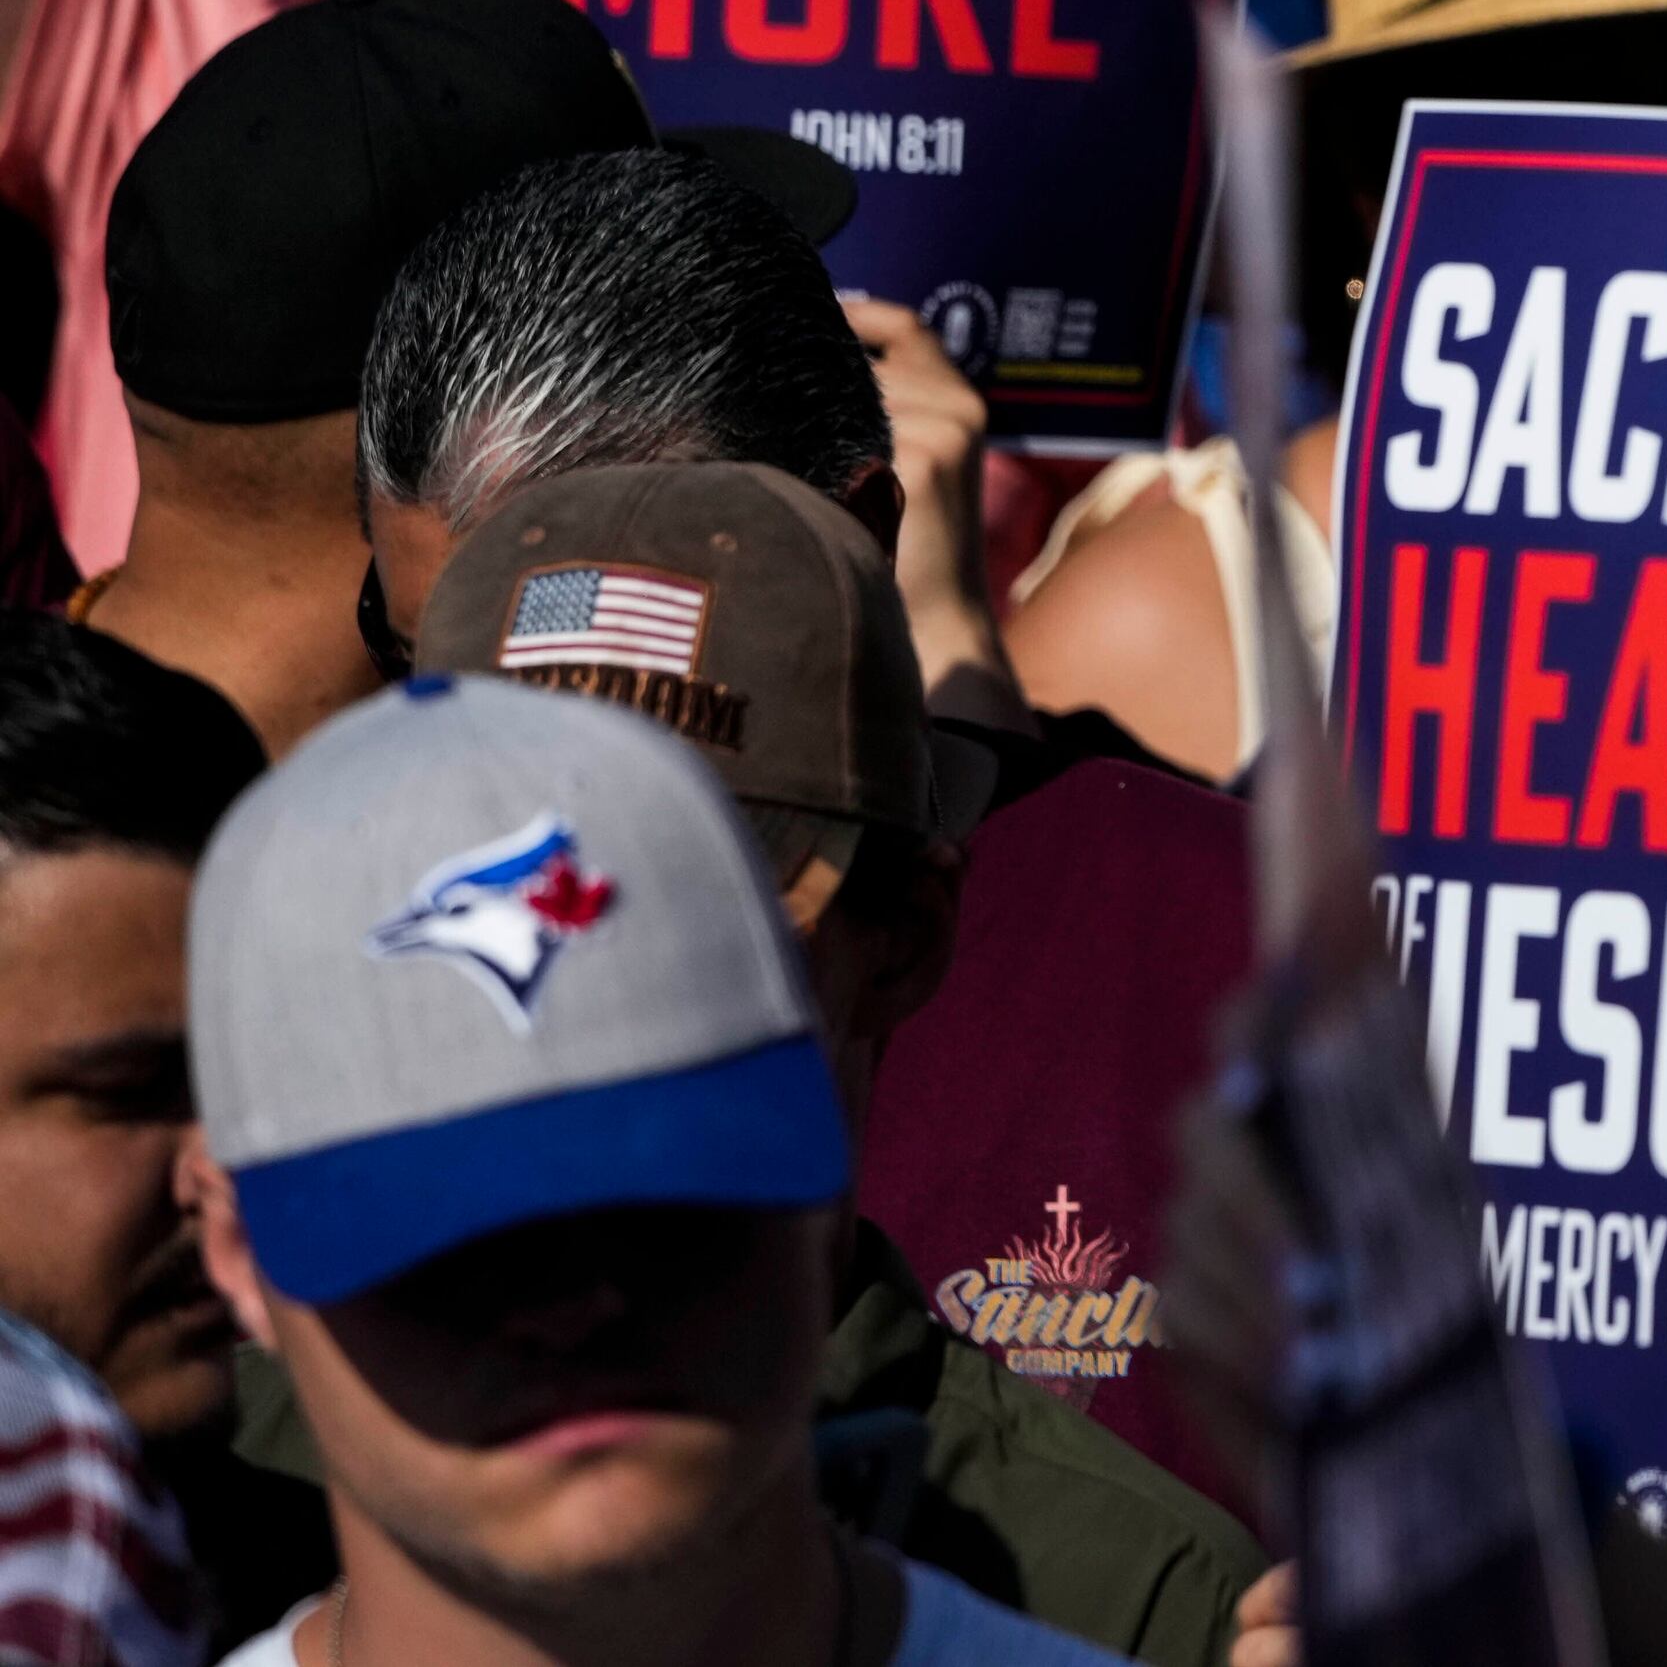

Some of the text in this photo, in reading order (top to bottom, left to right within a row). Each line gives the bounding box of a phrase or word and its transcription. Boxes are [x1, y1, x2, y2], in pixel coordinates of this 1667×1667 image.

[897, 113, 965, 176] 8:11
[985, 1257, 1035, 1286] THE
[1006, 1348, 1132, 1378] COMPANY
